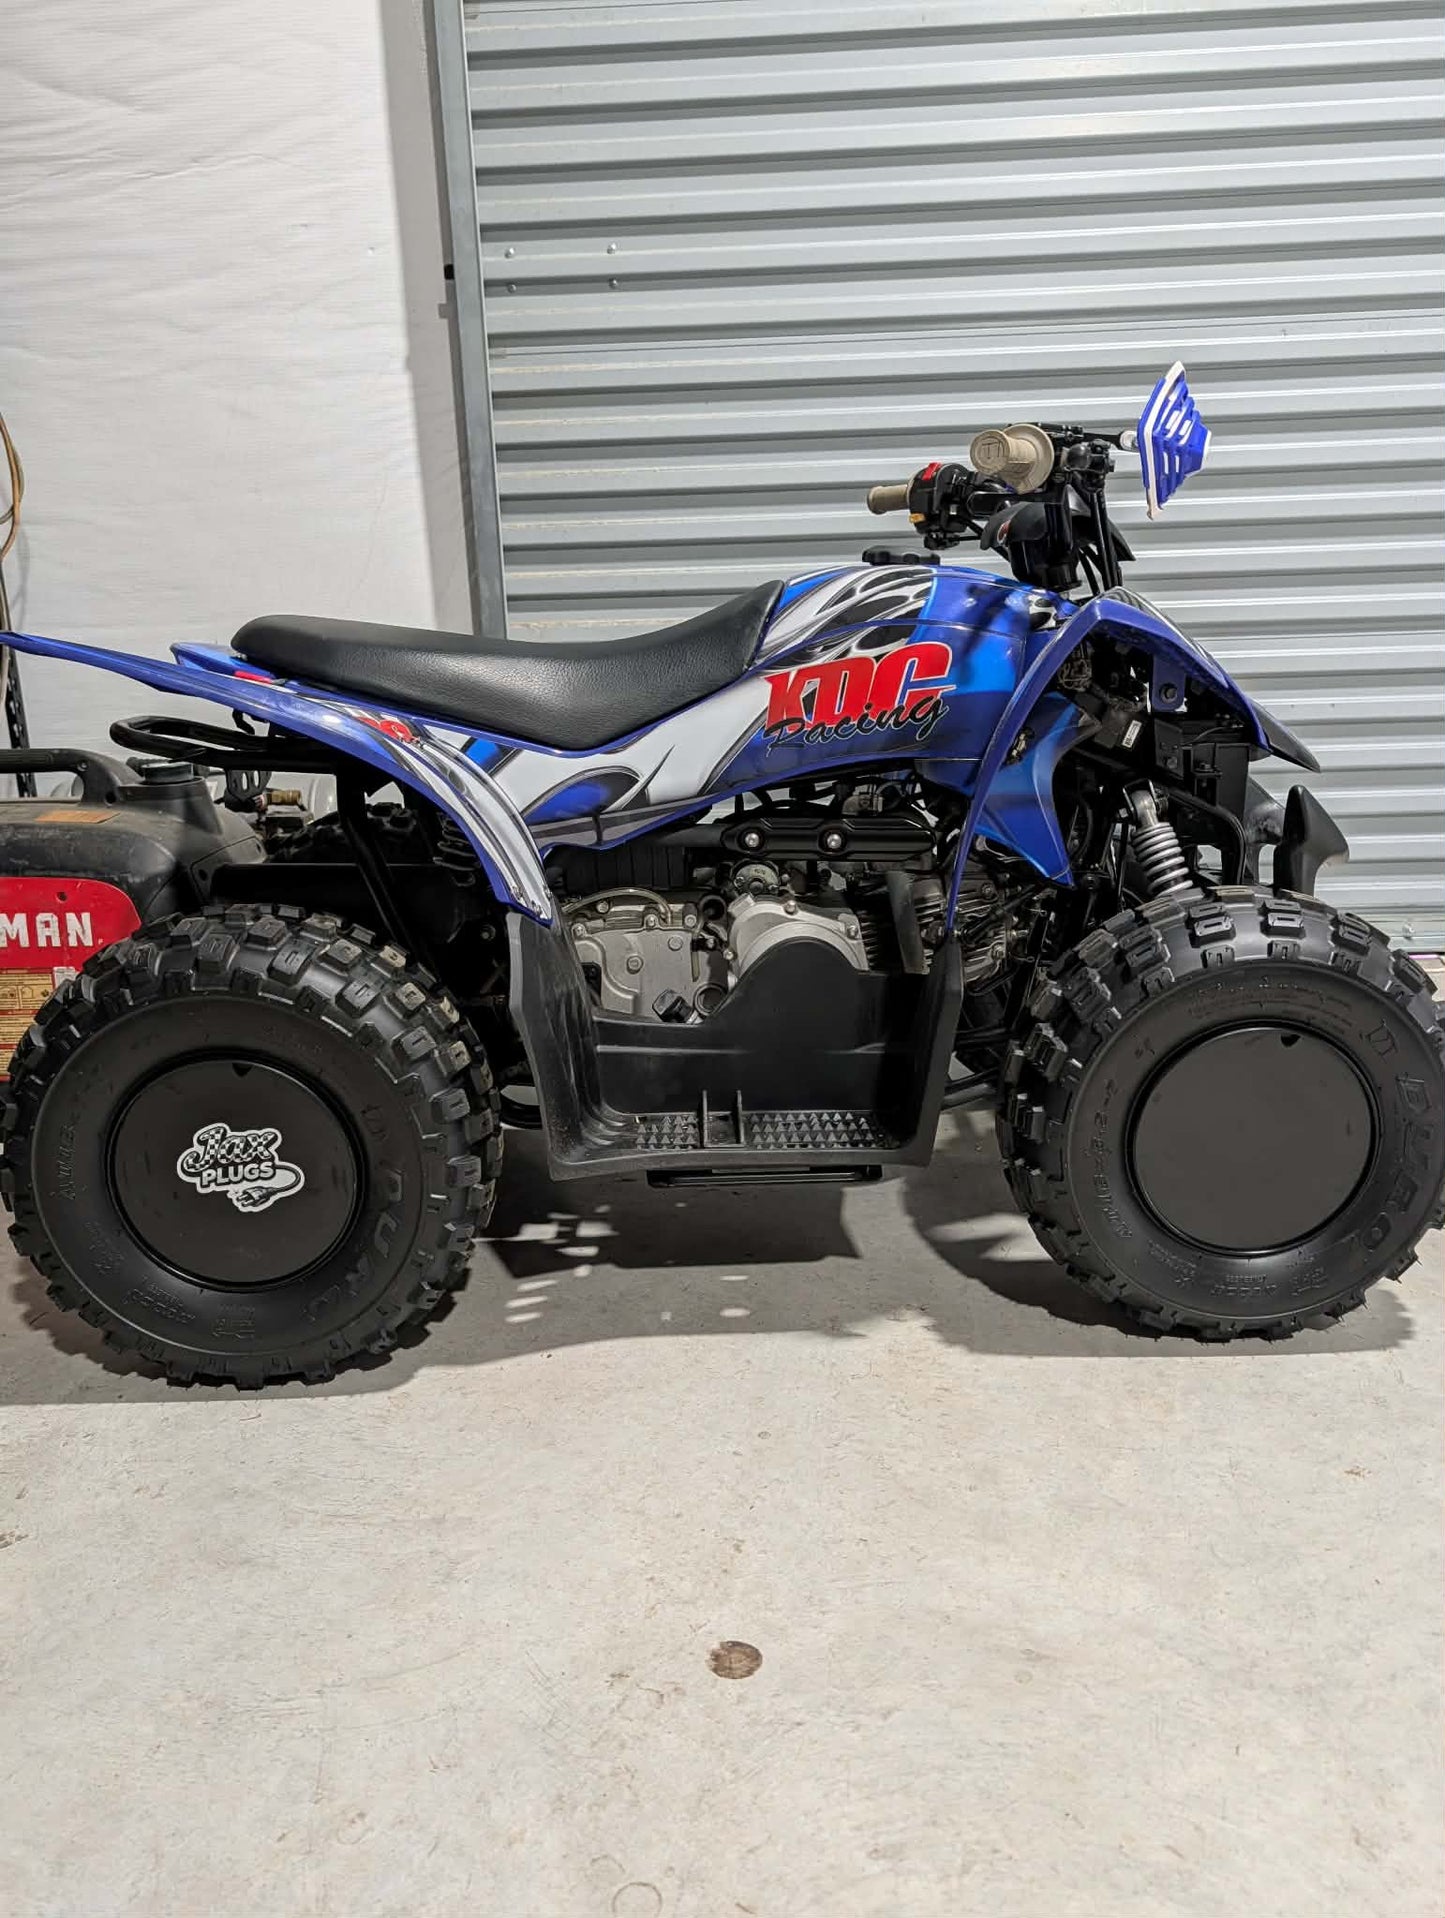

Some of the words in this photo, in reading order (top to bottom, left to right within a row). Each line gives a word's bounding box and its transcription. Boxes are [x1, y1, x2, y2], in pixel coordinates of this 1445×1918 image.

[763, 695, 950, 757] Racing
[182, 1126, 276, 1173] Jax
[201, 1160, 275, 1187] PLUGS
